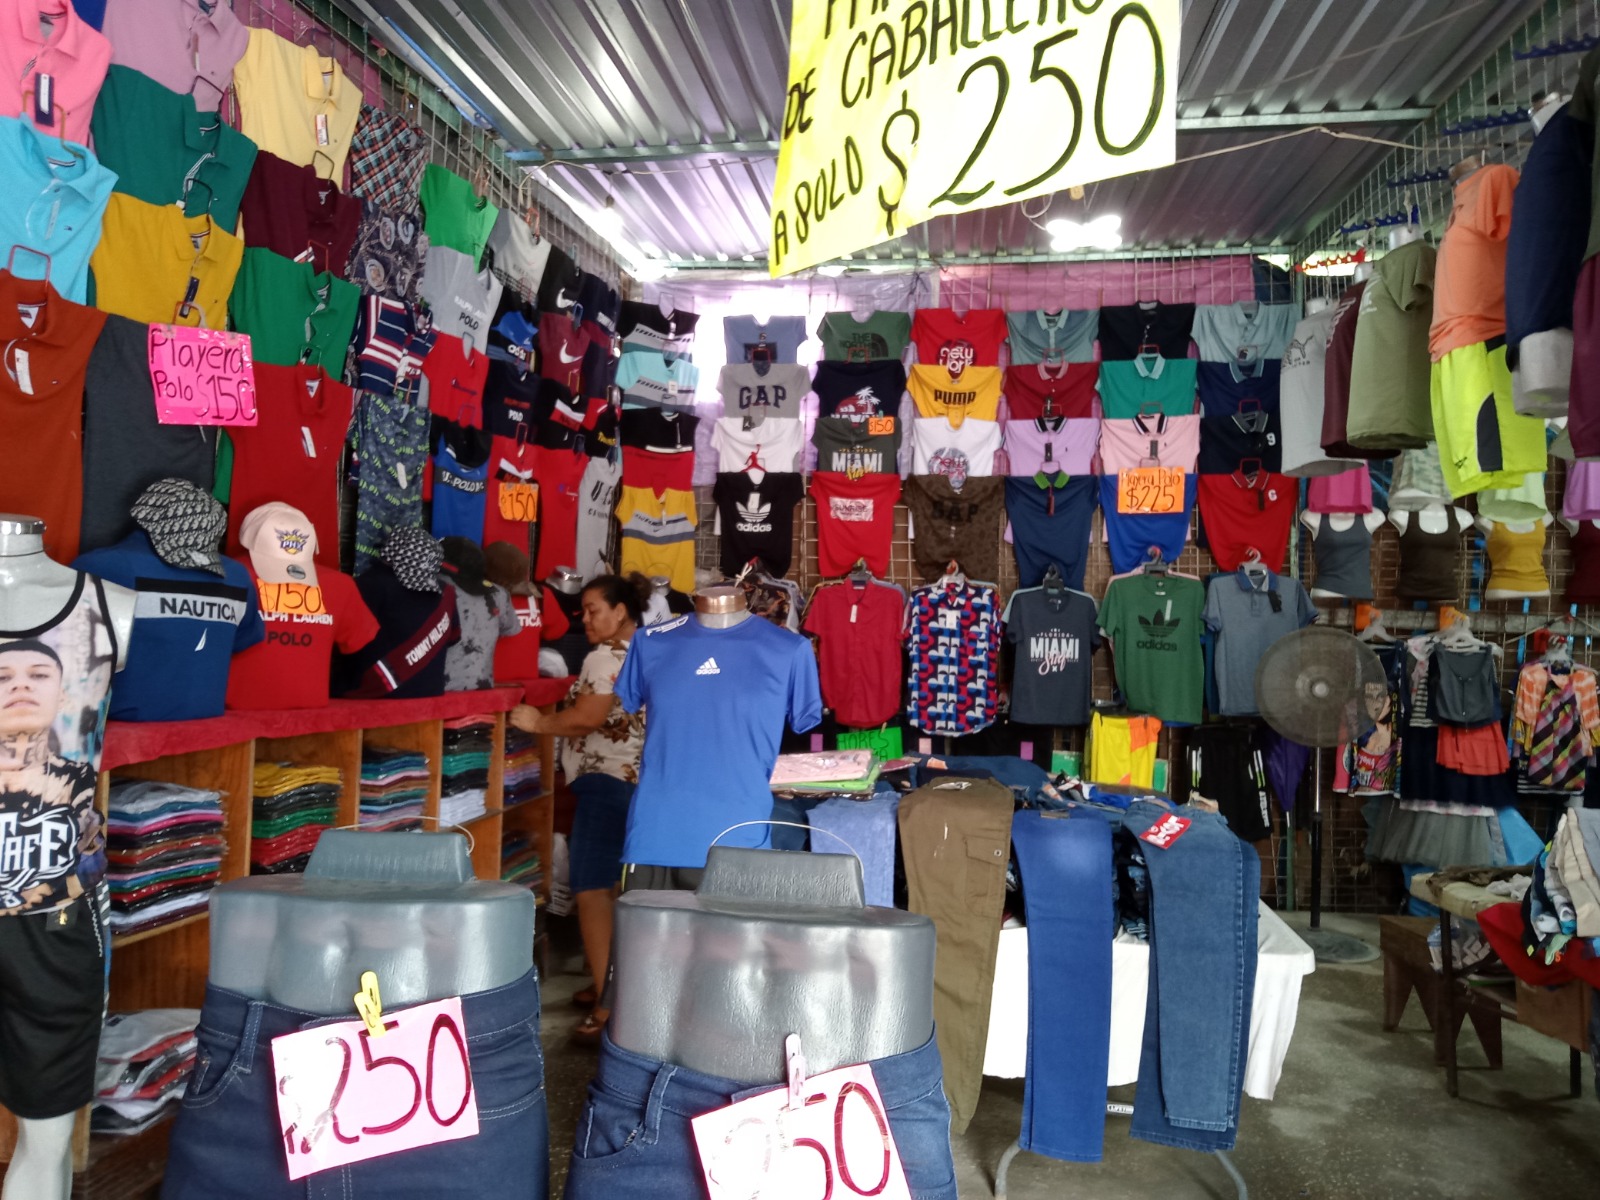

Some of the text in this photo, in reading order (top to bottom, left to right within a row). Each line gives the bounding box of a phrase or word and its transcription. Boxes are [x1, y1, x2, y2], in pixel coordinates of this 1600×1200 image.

[459, 312, 479, 330] POLO
[150, 327, 244, 374] Playera
[153, 369, 194, 401] Polo
[738, 384, 787, 410] GAP
[934, 388, 977, 406] PUMA
[831, 450, 883, 473] MIAMI
[1158, 467, 1181, 486] Polo
[1125, 484, 1175, 513] $225
[736, 520, 773, 533] adidas
[259, 582, 322, 614] $150
[160, 597, 237, 623] NAUTICA
[292, 612, 334, 626] LAUREN
[267, 630, 313, 647] POLO
[1030, 636, 1080, 660] MIAMI
[1136, 639, 1178, 651] adidas
[405, 636, 432, 666] TOMMY
